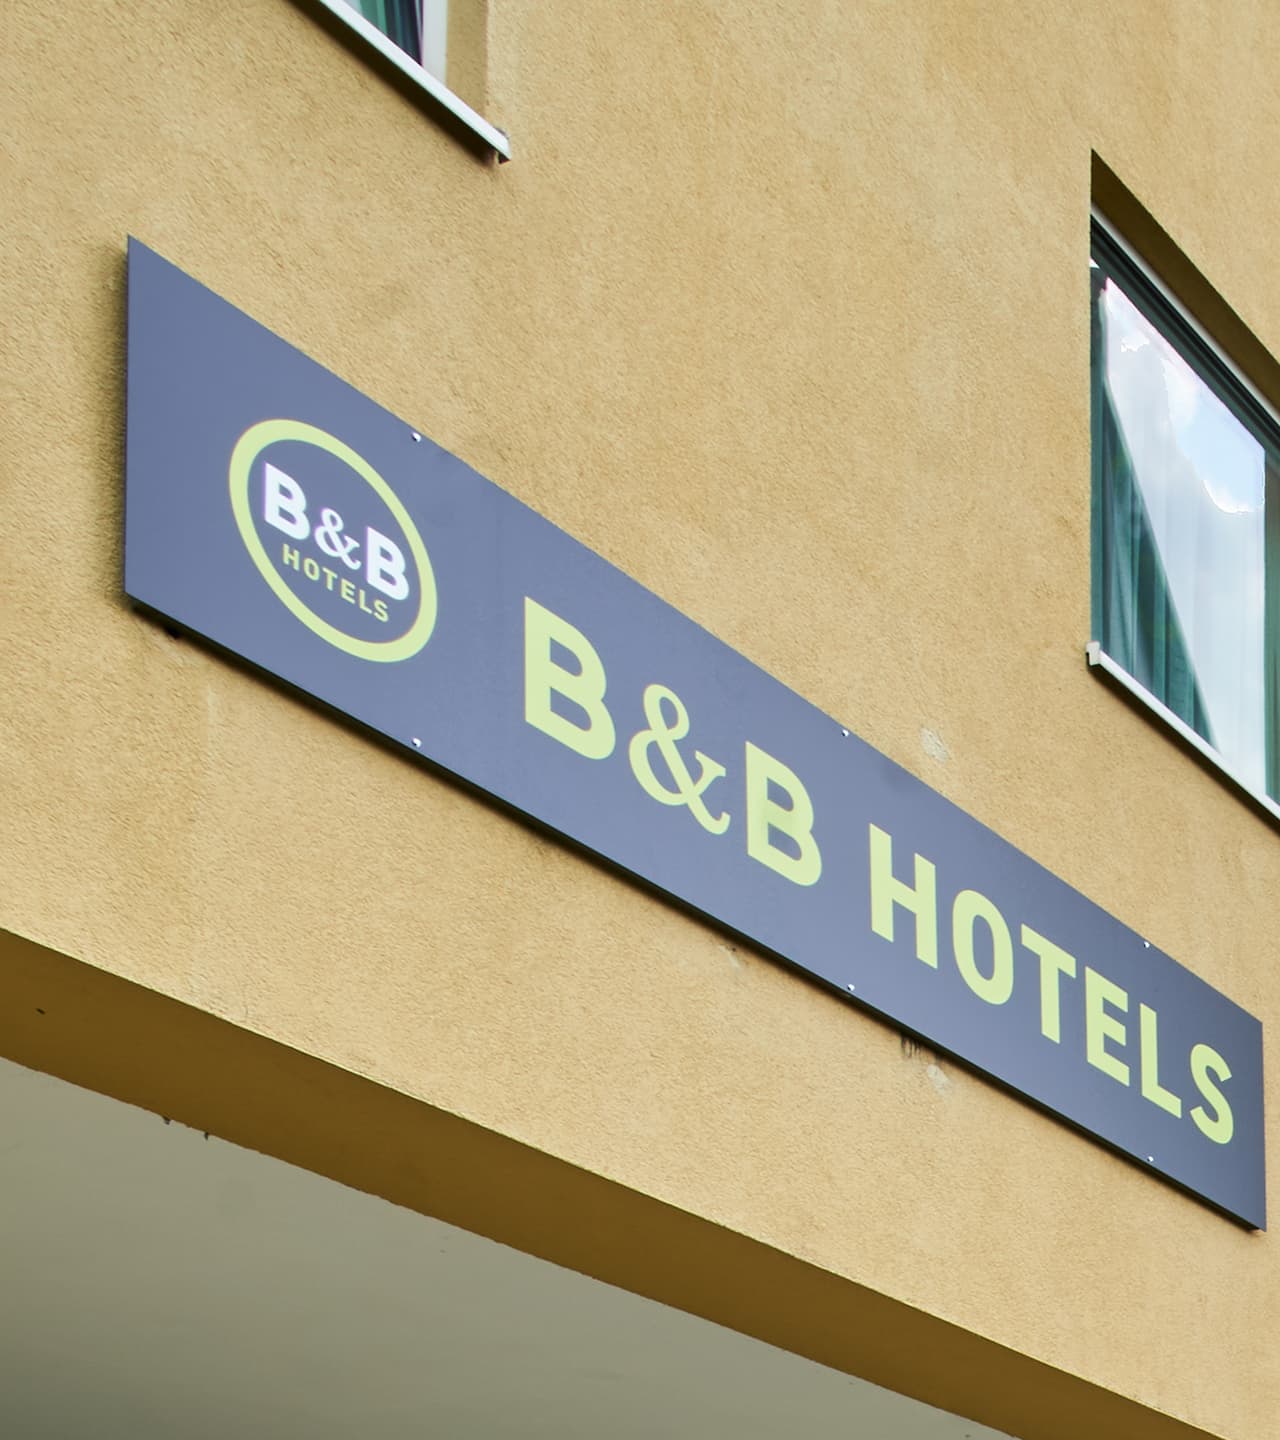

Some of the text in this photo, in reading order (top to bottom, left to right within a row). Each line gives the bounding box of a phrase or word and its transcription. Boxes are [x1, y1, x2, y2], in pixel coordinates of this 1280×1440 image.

[263, 461, 411, 602] B&B
[282, 543, 389, 623] HOTELS
[524, 596, 1235, 1146] B&B HOTELS
